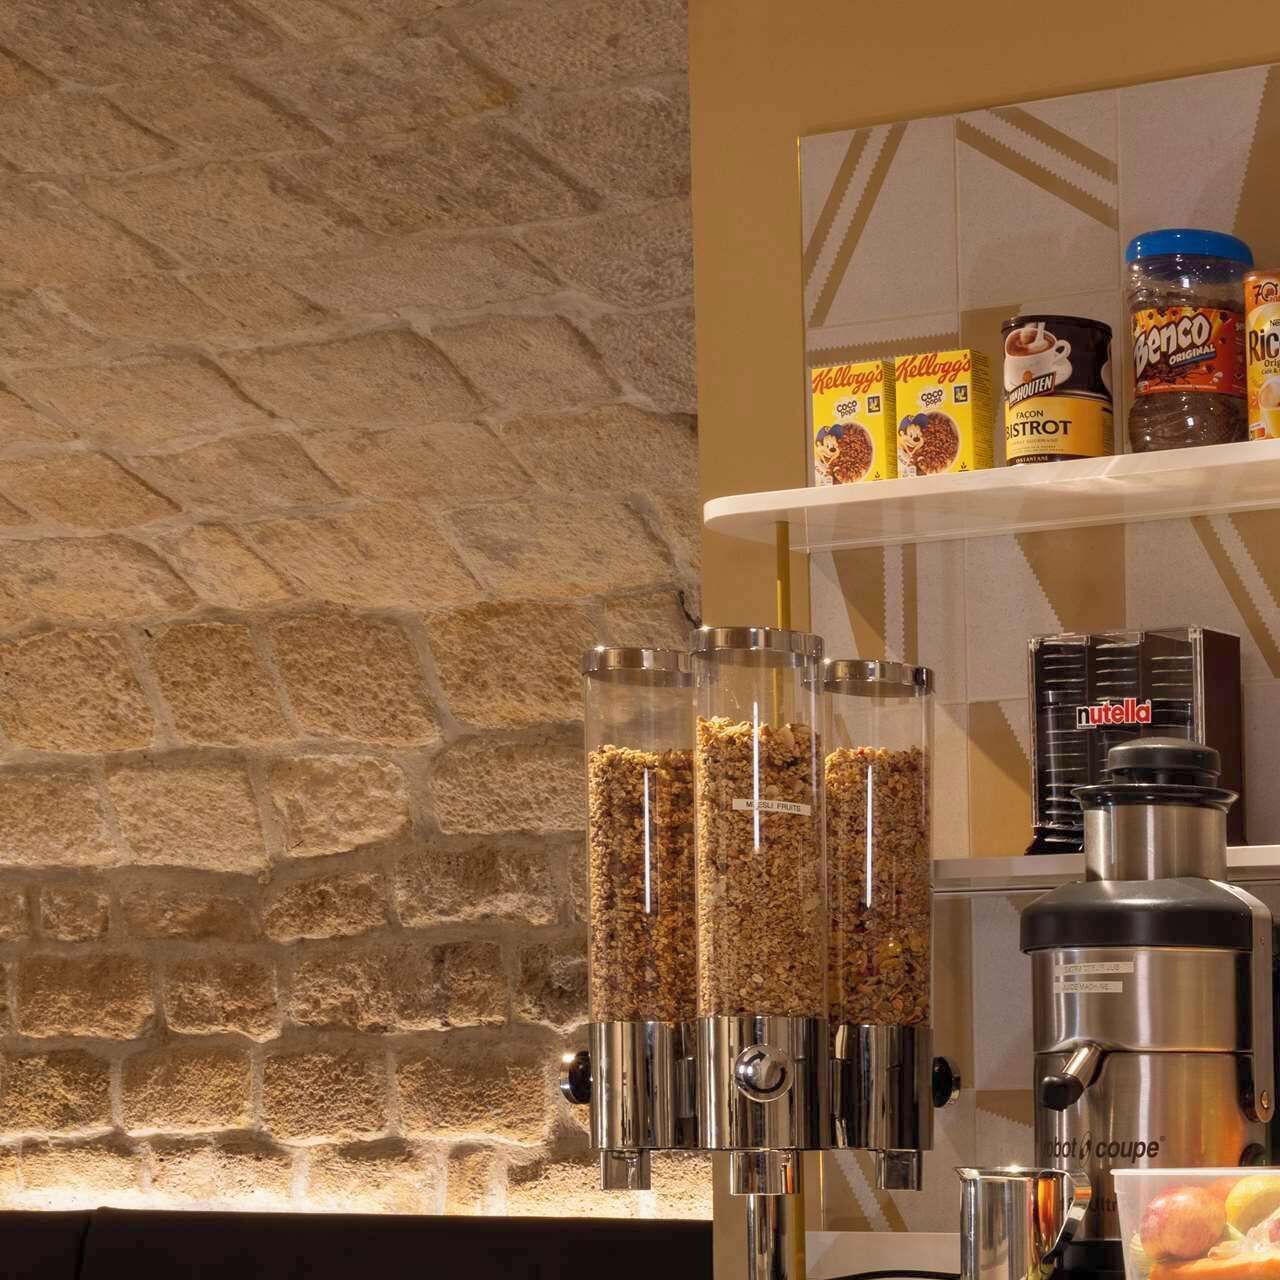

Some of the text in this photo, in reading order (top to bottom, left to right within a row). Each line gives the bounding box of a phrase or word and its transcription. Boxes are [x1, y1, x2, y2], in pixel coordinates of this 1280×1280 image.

[1133, 312, 1213, 380] Benco
[1168, 343, 1216, 366] ORIGINAL
[812, 363, 883, 395] Kellogg's
[895, 352, 972, 384] Kellogg's
[1016, 374, 1054, 402] HOUTEN
[1016, 409, 1044, 421] FAÇON
[1006, 419, 1073, 441] BISTROT
[1076, 697, 1152, 725] nutella
[745, 800, 774, 809] MESLI
[1095, 1139, 1160, 1164] coupe
